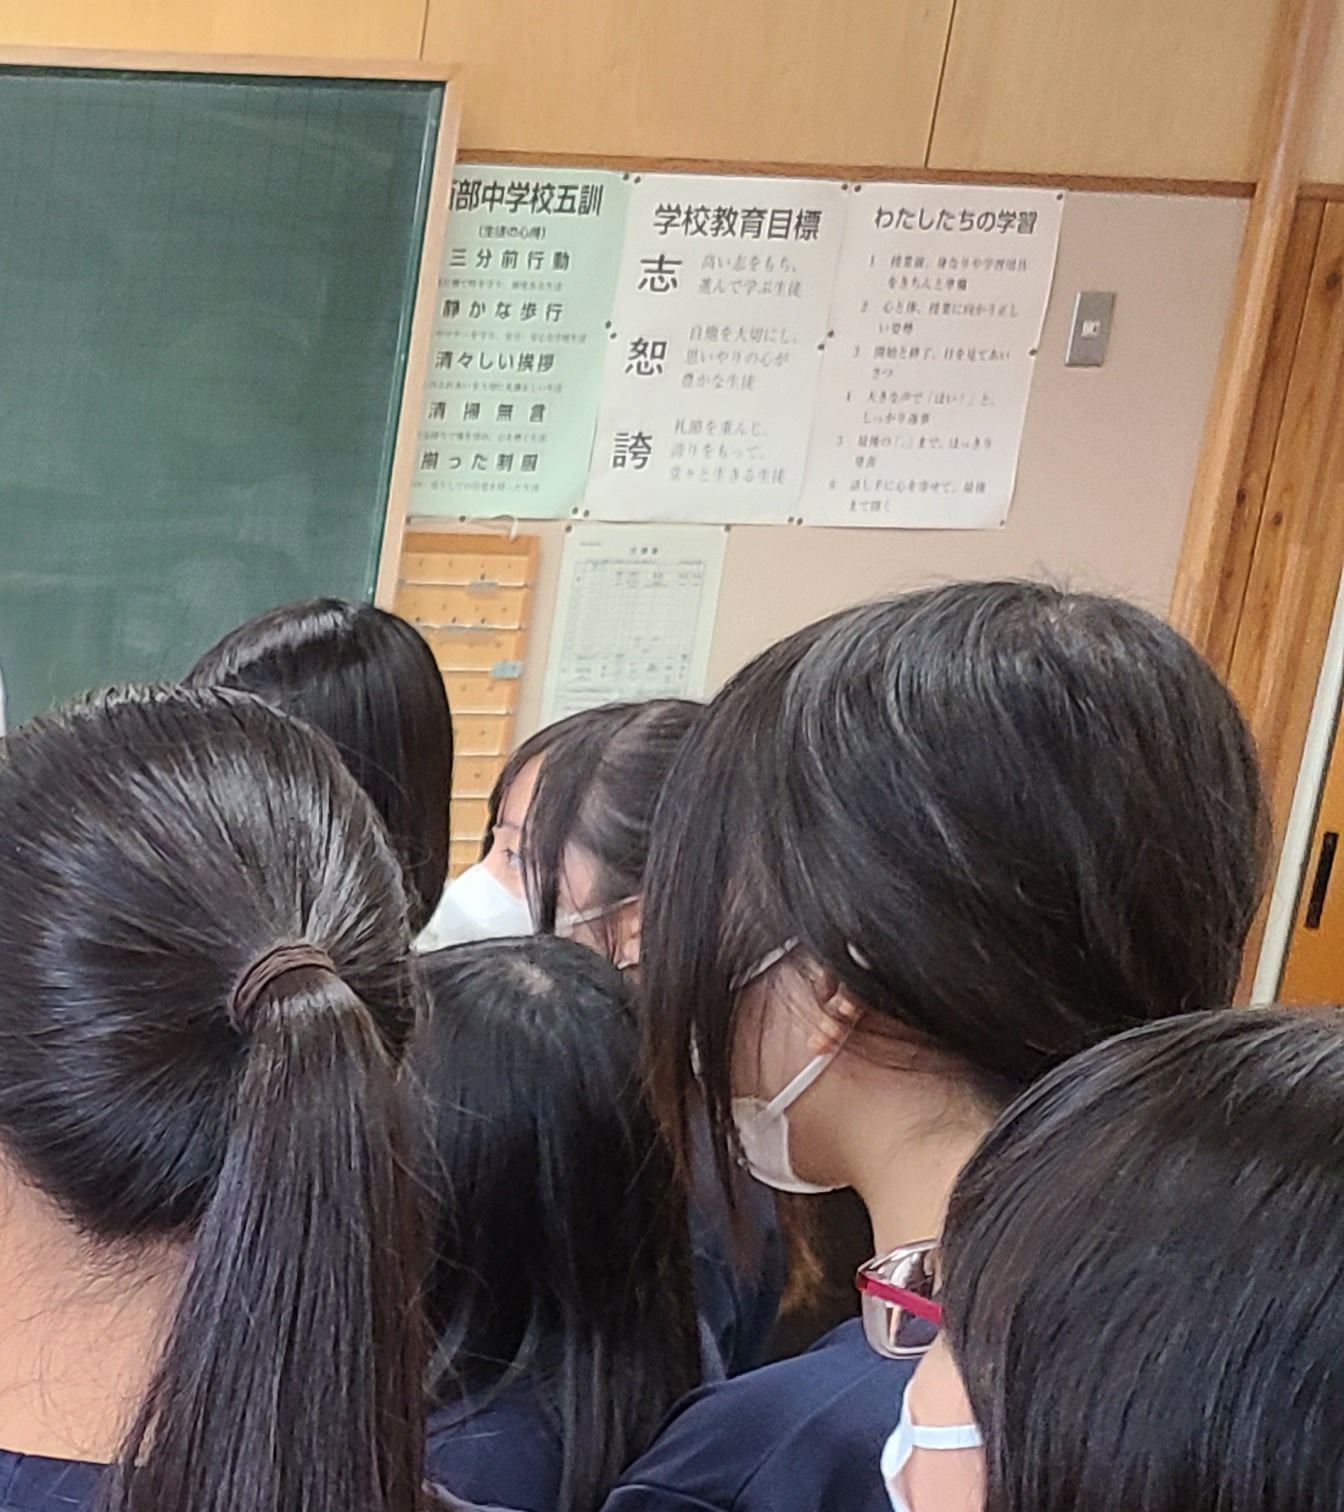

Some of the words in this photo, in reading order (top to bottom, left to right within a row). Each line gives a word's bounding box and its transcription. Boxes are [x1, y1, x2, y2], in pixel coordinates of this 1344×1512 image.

[448, 180, 604, 217] 部中学校五訓
[653, 203, 823, 241] 学校教育目標
[874, 206, 1038, 235] わたしたちの学習
[449, 248, 570, 271] 三分前行動
[637, 254, 683, 293] 志
[442, 299, 563, 322] 静かな歩行
[435, 350, 555, 373] 清々しい挨拶
[624, 337, 667, 376] 恕
[612, 431, 653, 470] 誇
